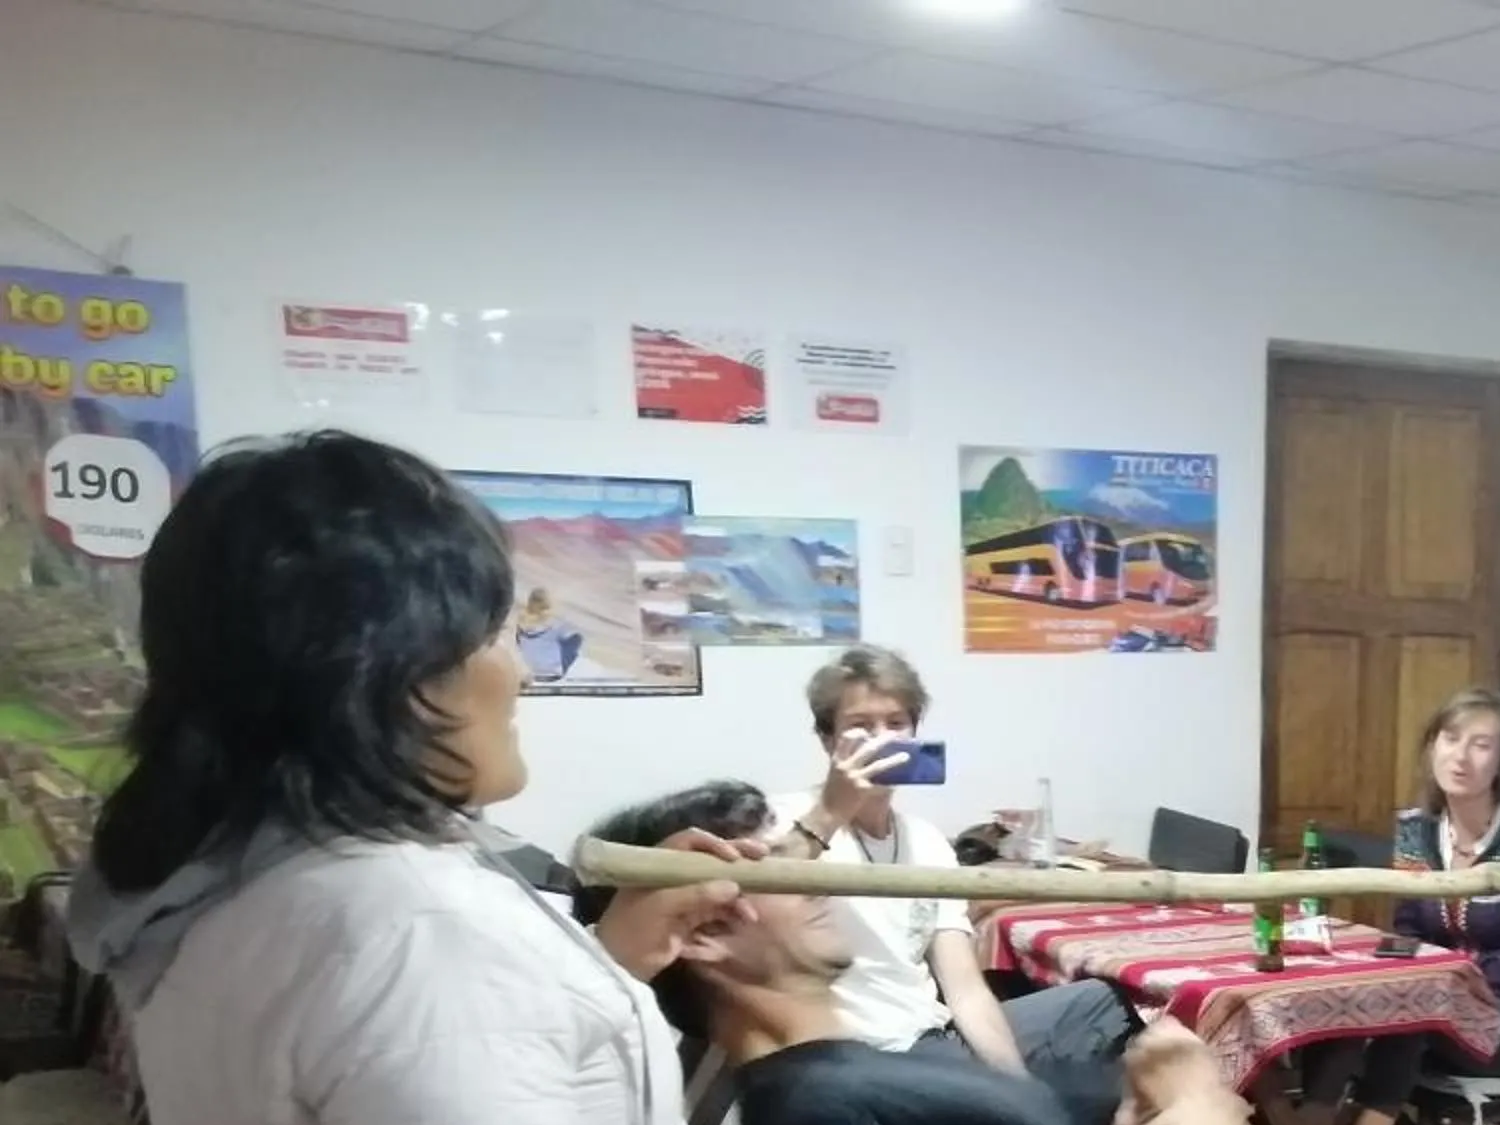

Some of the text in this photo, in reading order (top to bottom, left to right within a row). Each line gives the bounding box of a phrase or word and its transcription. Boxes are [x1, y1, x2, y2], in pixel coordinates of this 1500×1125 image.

[7, 283, 149, 340] to go
[0, 346, 177, 397] by car
[50, 460, 140, 504] 190
[1110, 455, 1214, 477] TITICACA
